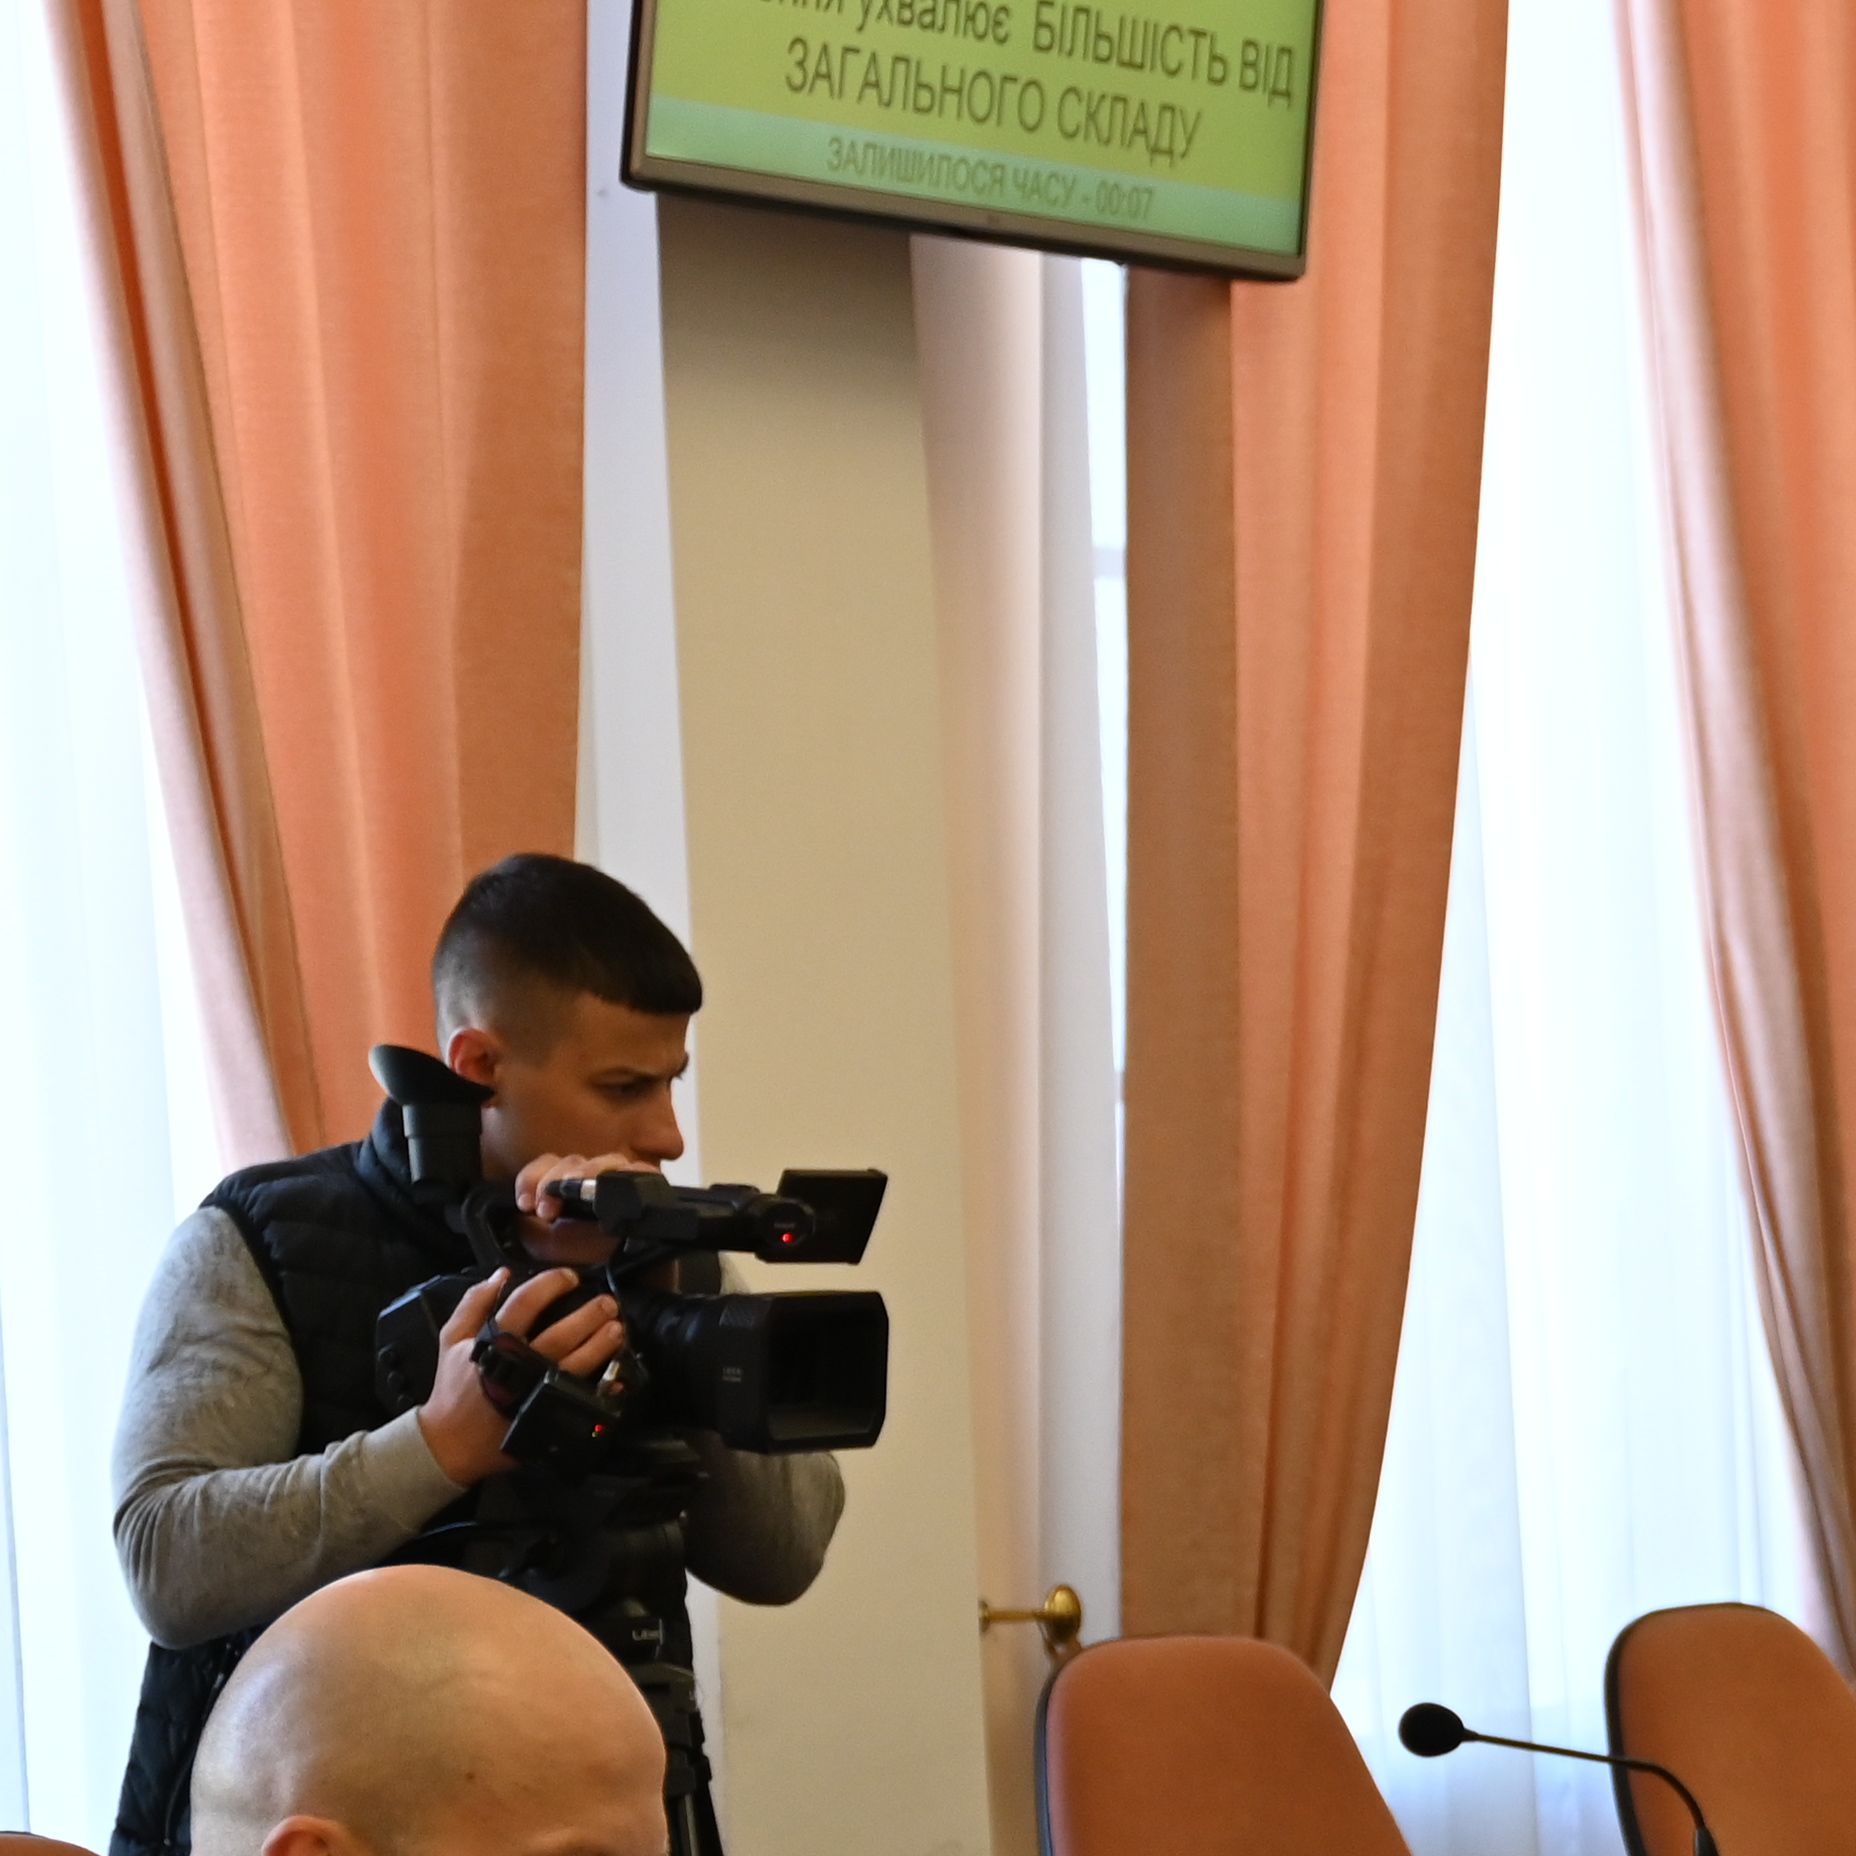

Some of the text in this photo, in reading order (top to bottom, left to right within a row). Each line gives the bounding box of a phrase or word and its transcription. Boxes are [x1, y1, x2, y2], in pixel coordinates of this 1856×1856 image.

[785, 36, 1202, 168] ЗАГАЛЬНОГО СКЛАДУ
[1032, 0, 1227, 86] БІЛЬШІСТЬ
[1239, 38, 1293, 109] ВІД
[827, 136, 1006, 198] ЗАЛИШИЛОСЯ
[1011, 168, 1077, 208] ЧАСУ
